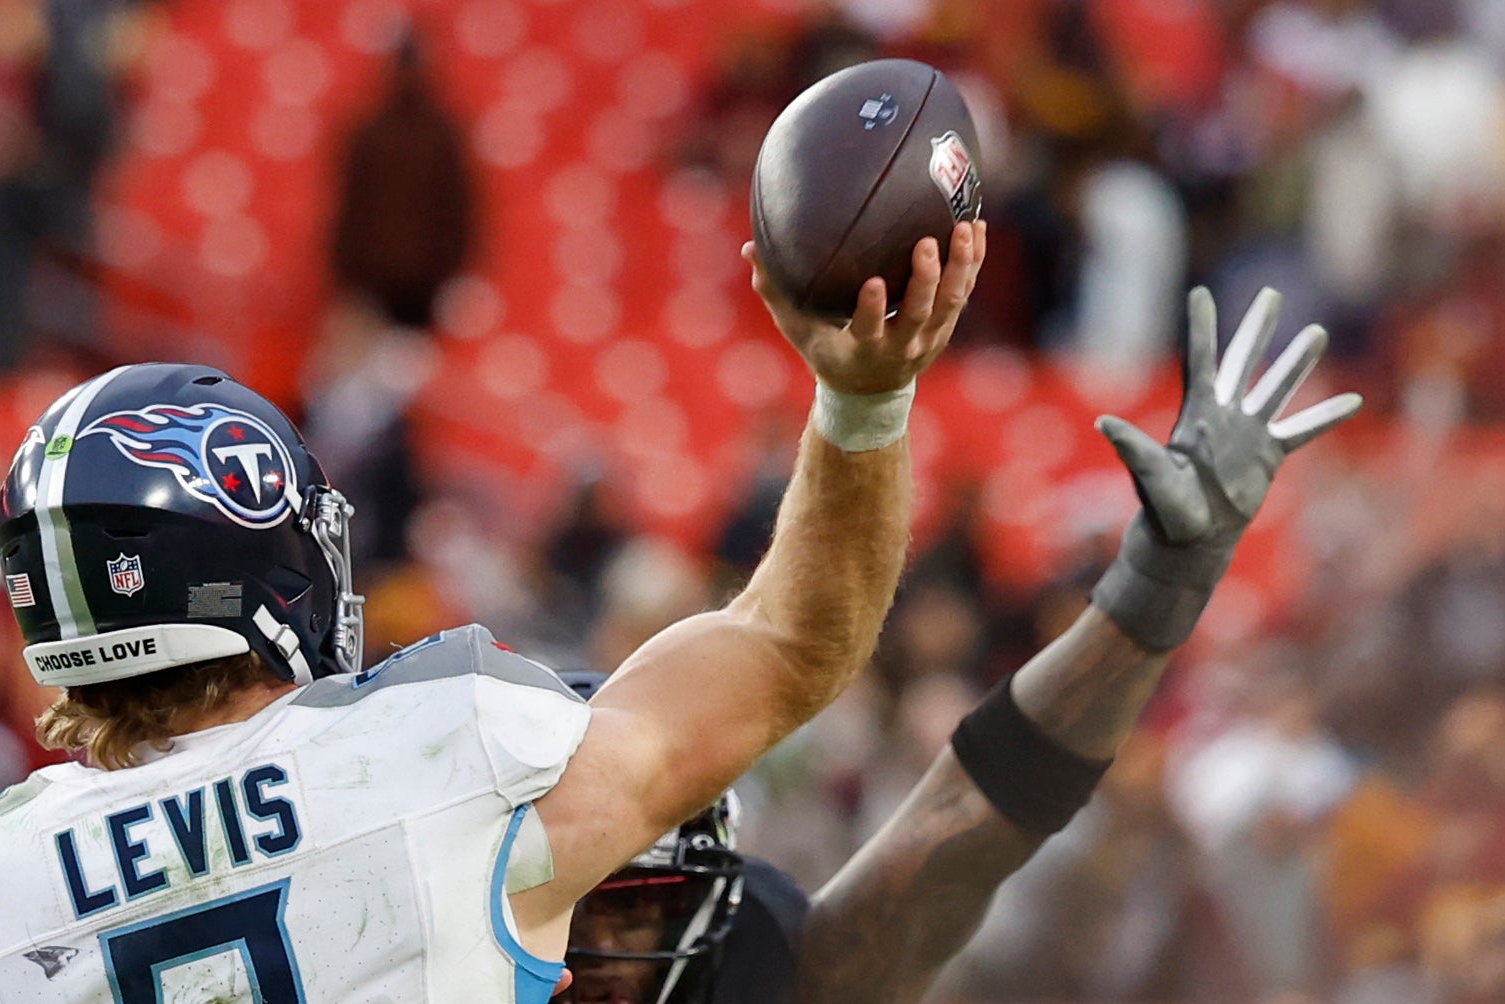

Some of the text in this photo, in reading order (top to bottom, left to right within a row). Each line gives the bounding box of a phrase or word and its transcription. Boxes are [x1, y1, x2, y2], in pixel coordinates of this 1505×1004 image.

[211, 444, 272, 504] T
[113, 570, 140, 588] NFL
[35, 637, 157, 672] CHOOSE LOVE
[54, 763, 302, 919] LEVIS
